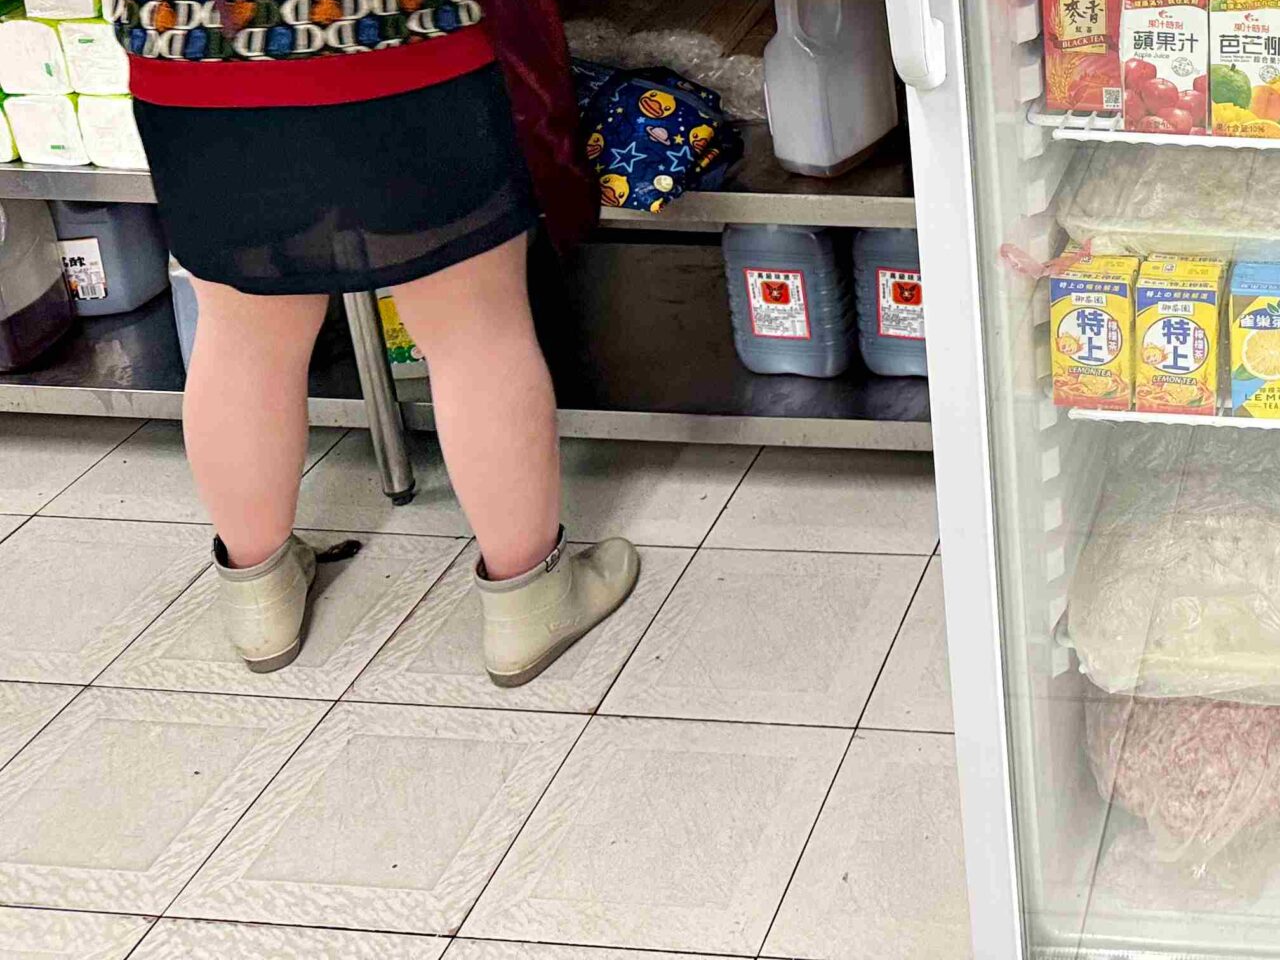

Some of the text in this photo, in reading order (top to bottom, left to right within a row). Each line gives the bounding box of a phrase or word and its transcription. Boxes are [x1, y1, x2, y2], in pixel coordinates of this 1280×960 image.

[1062, 35, 1105, 49] BLACK TEA
[1133, 30, 1199, 54] 蘋果汁
[1076, 309, 1105, 363] 特上
[1162, 319, 1191, 372] 特上
